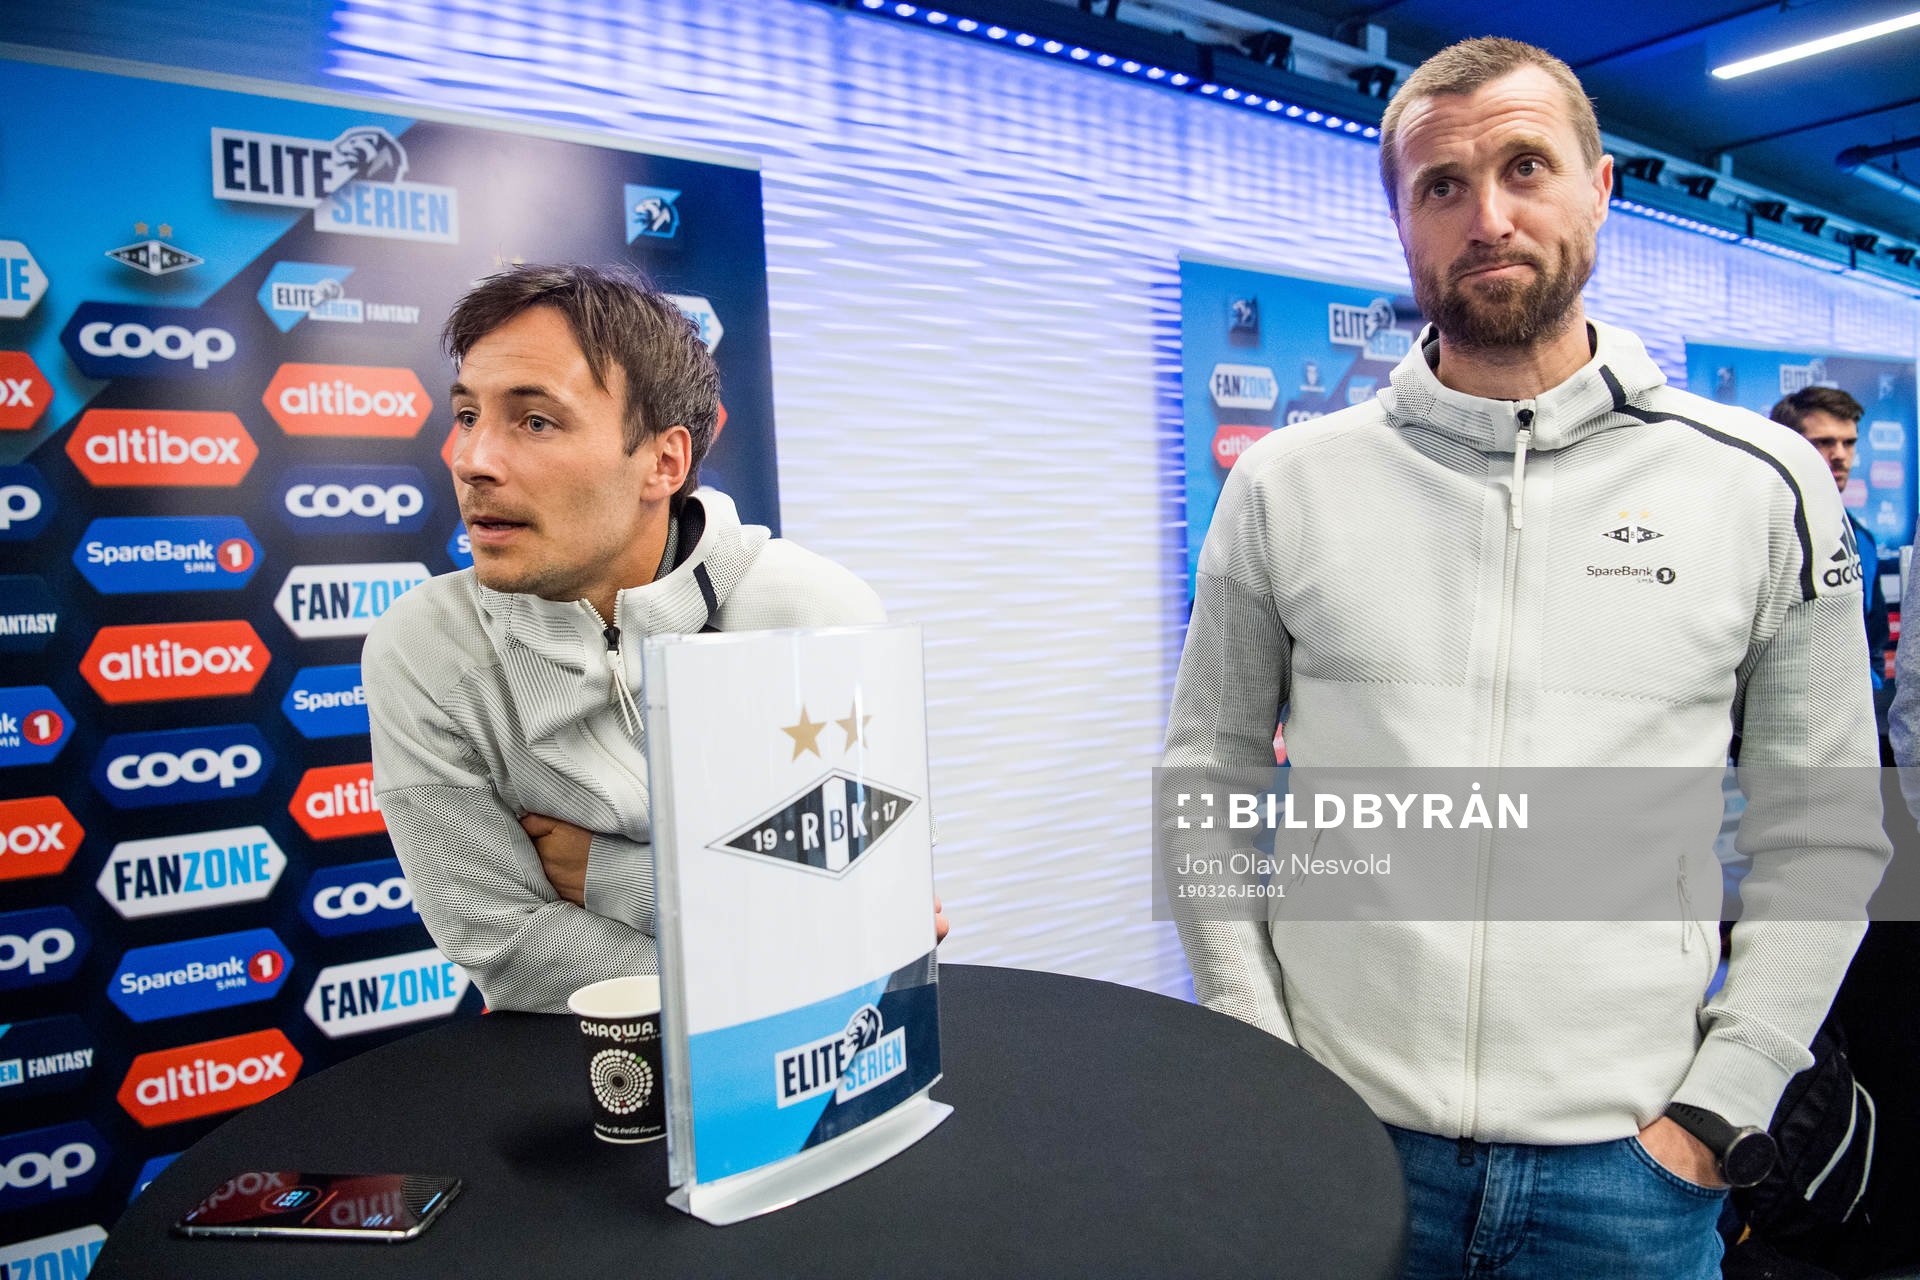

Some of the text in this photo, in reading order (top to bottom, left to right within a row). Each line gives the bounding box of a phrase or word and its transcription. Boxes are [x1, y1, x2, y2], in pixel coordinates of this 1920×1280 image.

[222, 137, 334, 199] ELITE
[331, 182, 449, 235] SERIEN
[276, 287, 317, 307] ELITE
[365, 302, 421, 324] FANTASY
[1333, 308, 1370, 341] ELITE
[79, 321, 237, 370] coop
[279, 380, 418, 418] altibox
[1215, 373, 1273, 397] FANZONE
[85, 426, 242, 465] altibox
[284, 484, 424, 525] coop
[86, 539, 214, 566] SpareBank
[184, 562, 216, 574] SMN
[1586, 565, 1653, 578] SpareBank
[291, 579, 427, 621] FANZO
[0, 613, 57, 636] ANTASY
[99, 640, 254, 682] altibox
[293, 685, 367, 713] SpareB
[106, 744, 263, 790] coop
[306, 777, 381, 819] alti
[114, 842, 271, 901] FANZONE
[312, 877, 419, 920] coo
[120, 955, 244, 995] SpareBank
[216, 977, 247, 992] SMN
[320, 962, 457, 1022] FANZONE
[580, 1020, 654, 1042] CHAQWA
[28, 1047, 94, 1079] FANTASY
[135, 1051, 287, 1106] altibox
[782, 1038, 846, 1099] ELITE
[844, 1036, 902, 1093] SERIEN
